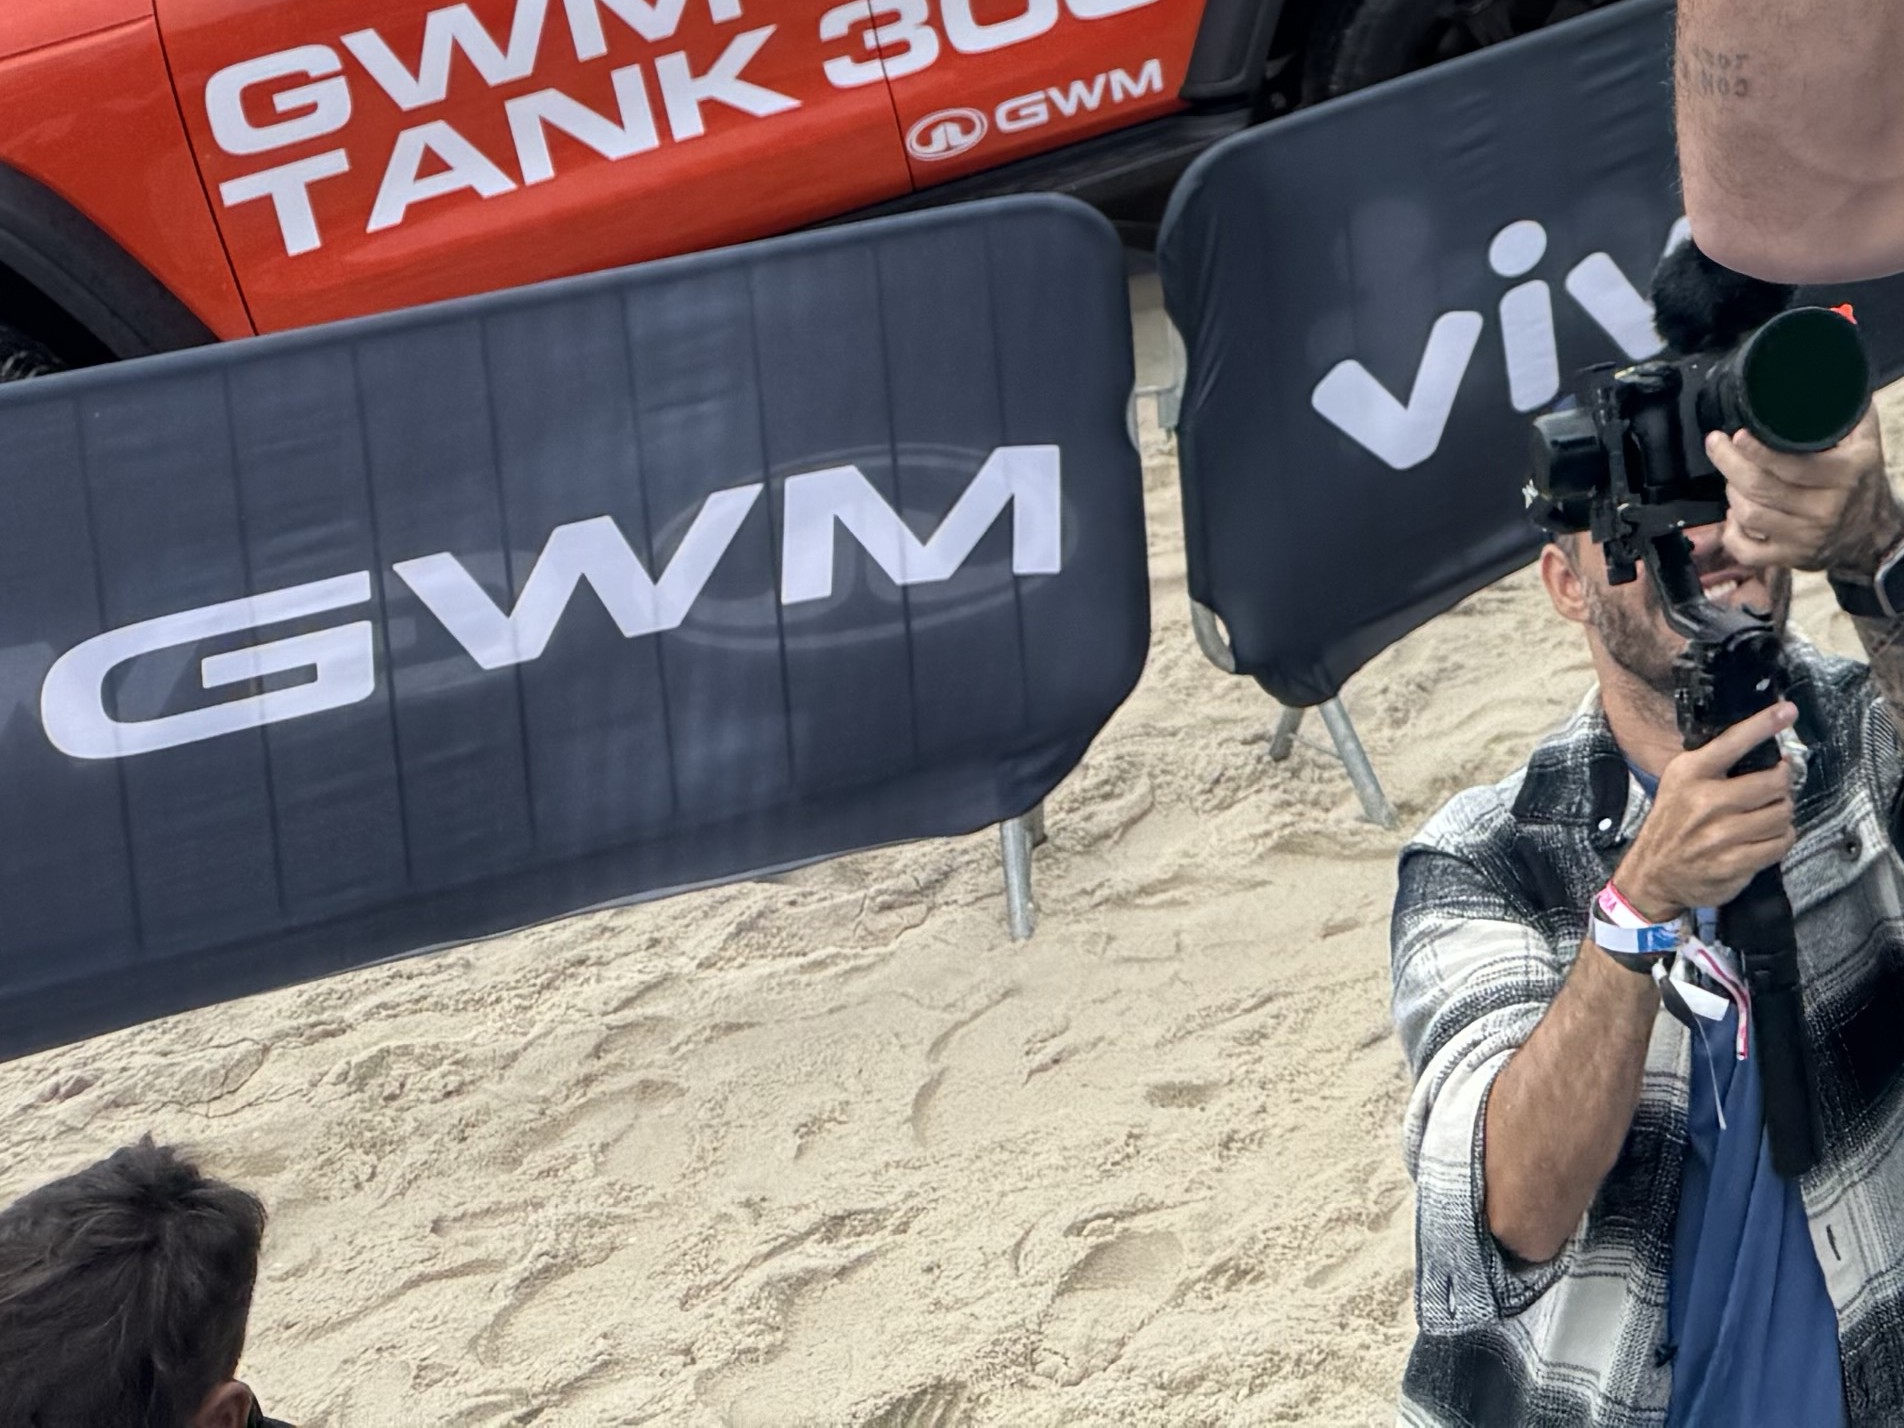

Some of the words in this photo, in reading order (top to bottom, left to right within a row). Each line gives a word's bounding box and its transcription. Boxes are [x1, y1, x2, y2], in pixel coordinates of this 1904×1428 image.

[219, 24, 802, 258] TANK
[994, 58, 1165, 134] GWM
[40, 444, 1061, 761] GWM
